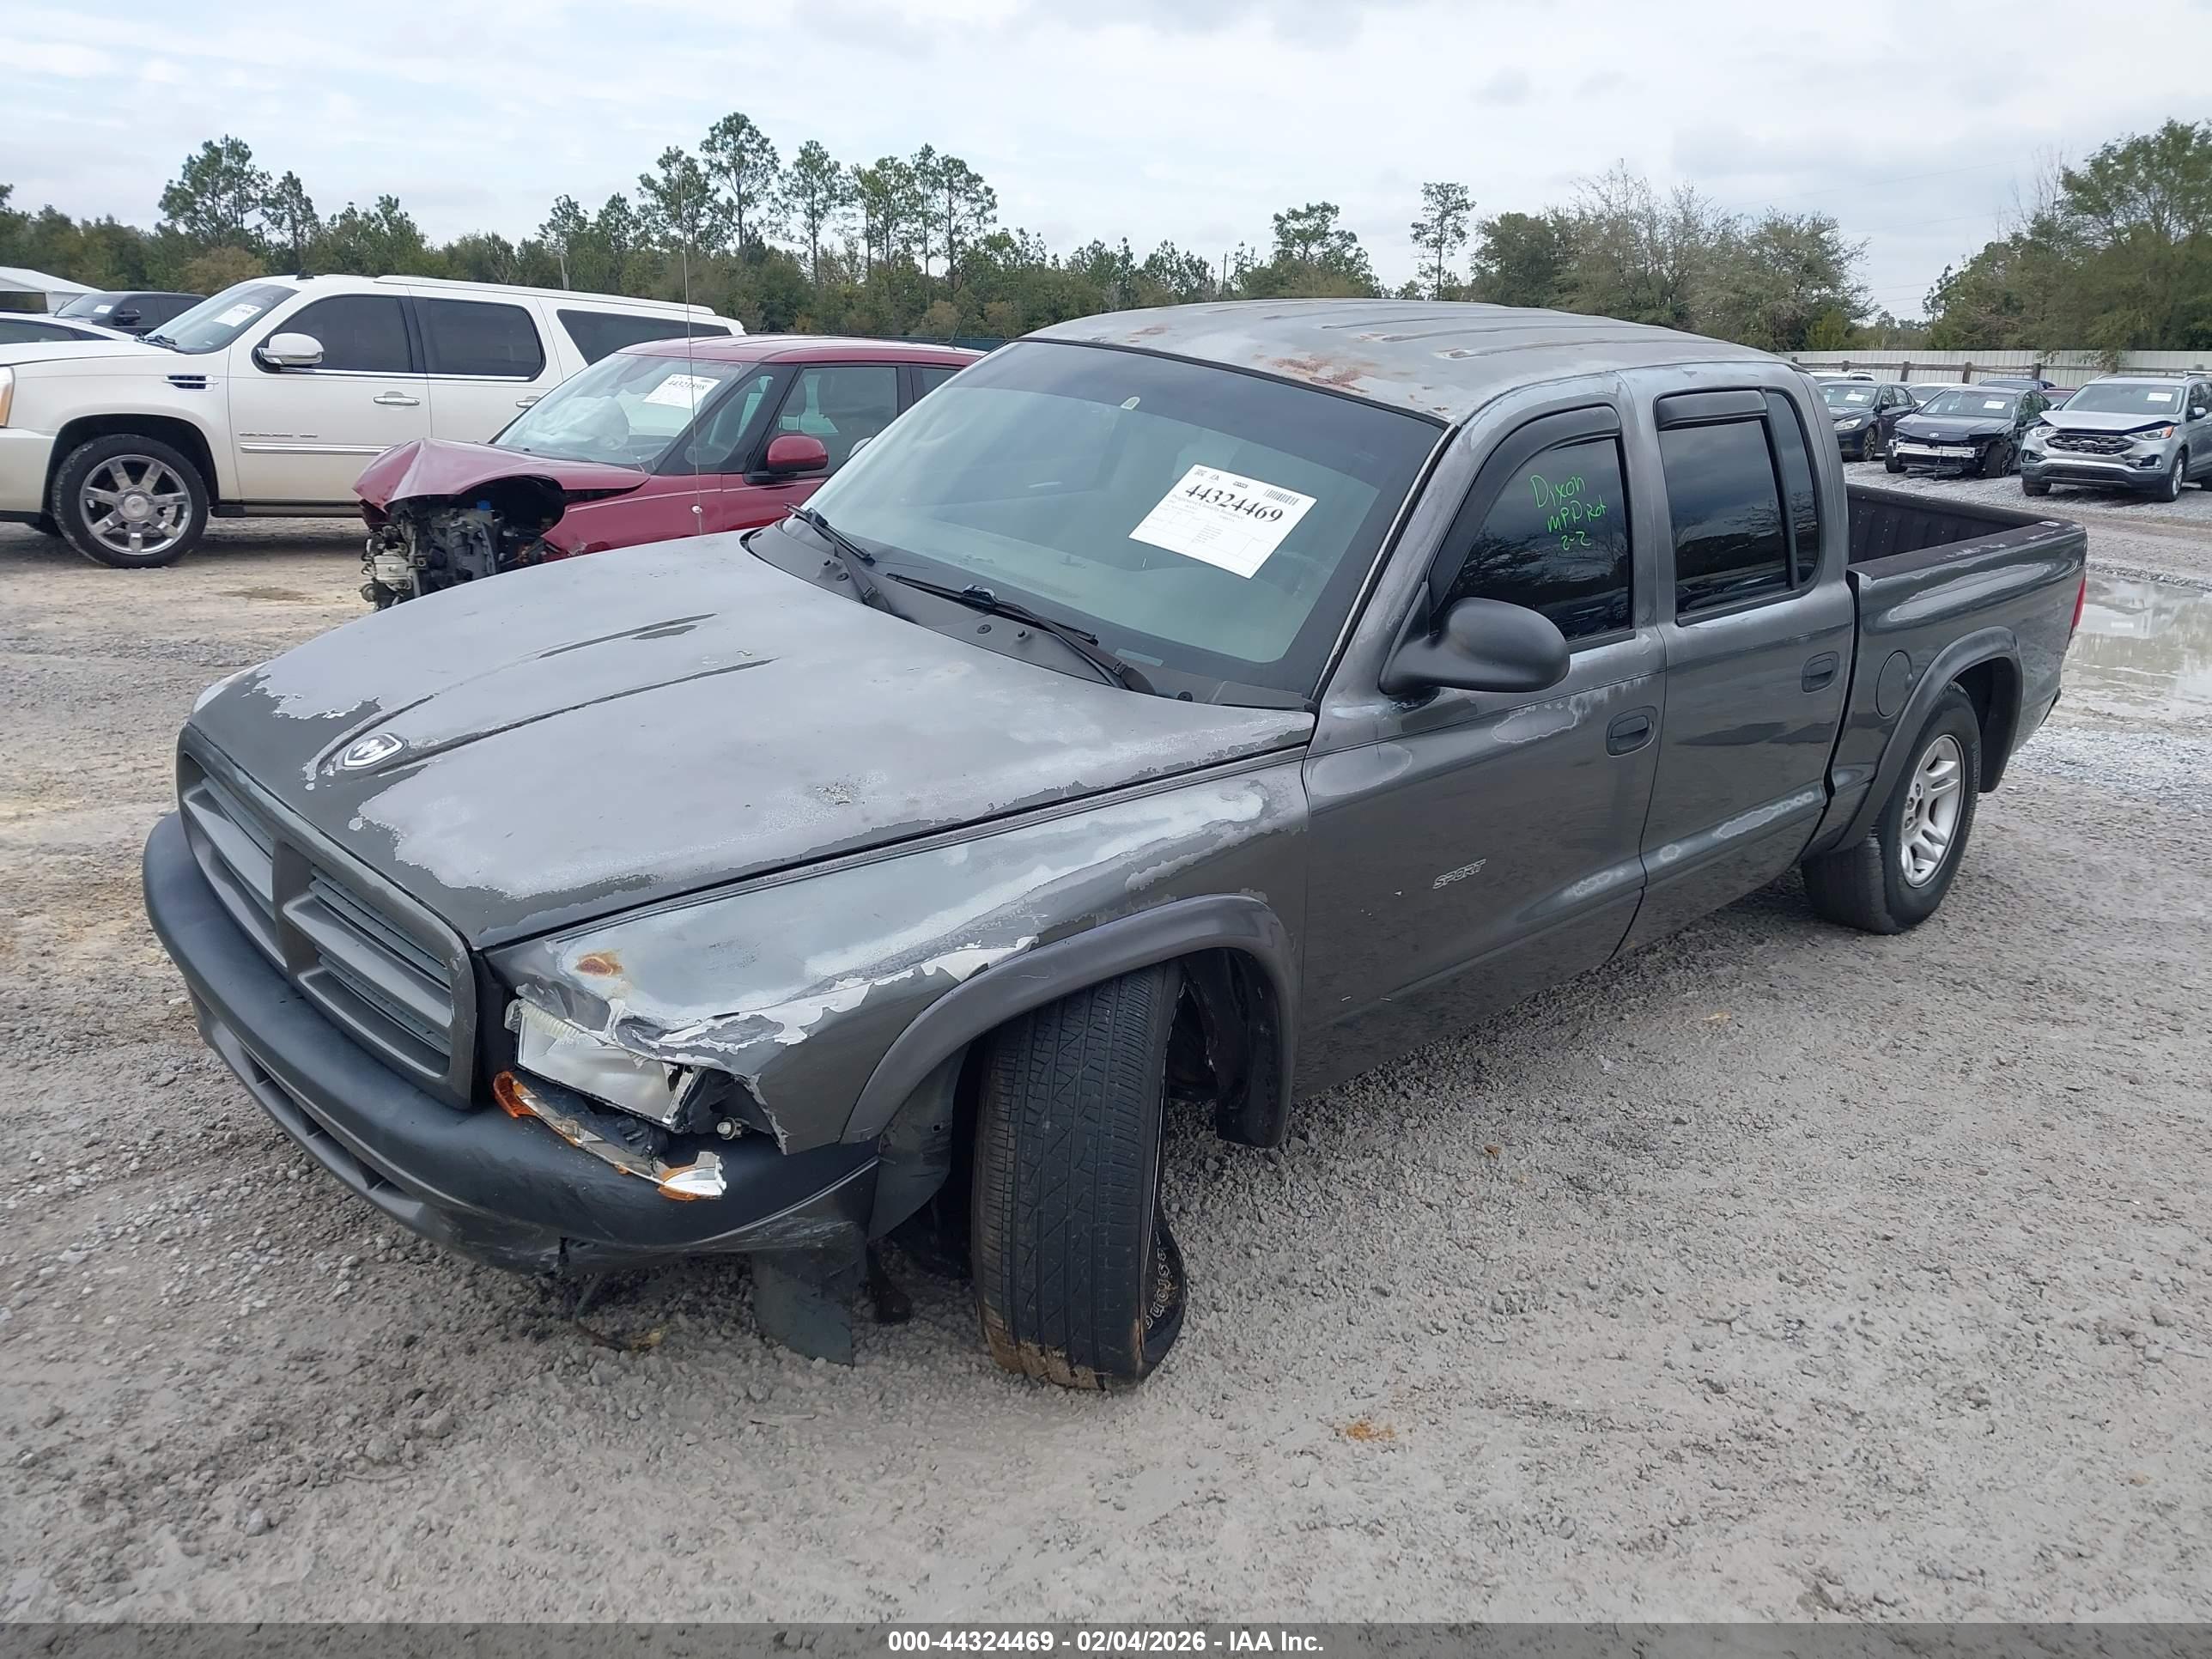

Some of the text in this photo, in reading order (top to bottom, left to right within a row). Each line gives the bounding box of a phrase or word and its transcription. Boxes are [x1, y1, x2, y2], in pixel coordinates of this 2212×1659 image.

[1185, 483, 1284, 523] 44324469
[1530, 474, 1586, 508] Dixon
[1561, 531, 1592, 550] 2-2
